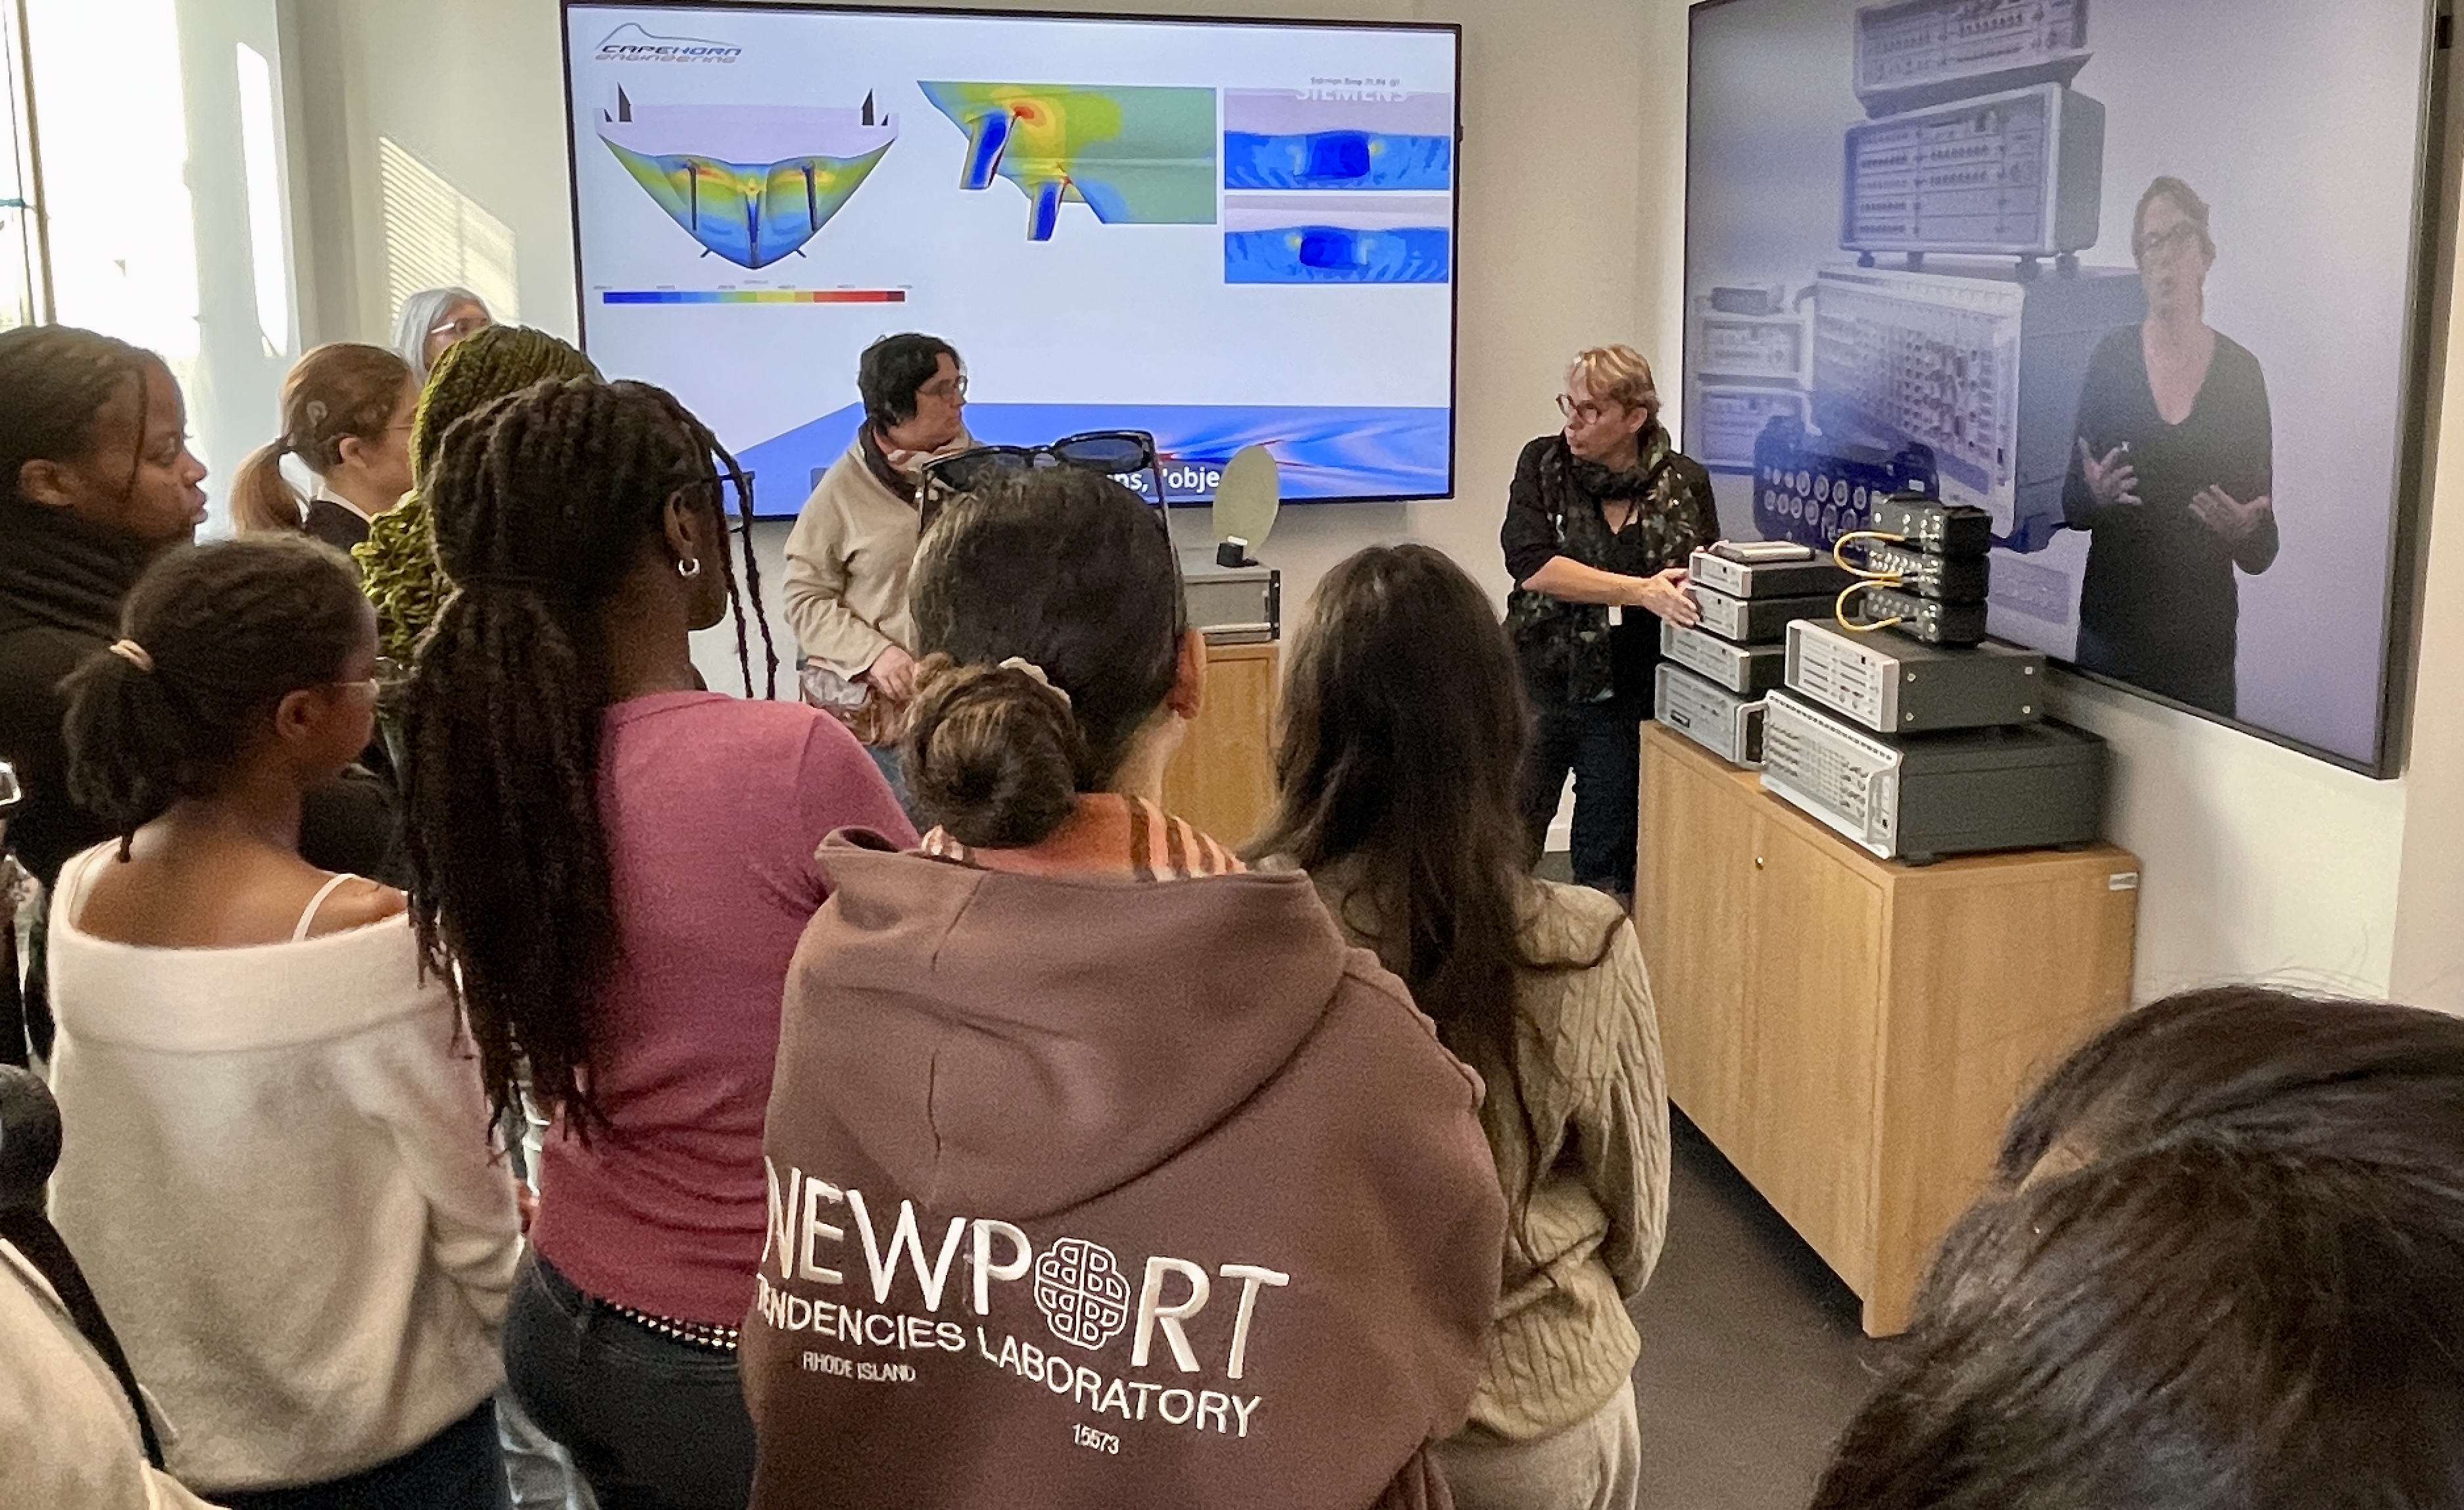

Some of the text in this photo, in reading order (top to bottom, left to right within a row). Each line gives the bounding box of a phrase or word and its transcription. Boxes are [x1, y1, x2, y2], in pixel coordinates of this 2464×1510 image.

[1106, 472, 1150, 493] ns,
[802, 1351, 916, 1382] RHODE ISLAND
[977, 1325, 1262, 1438] LABORATORY
